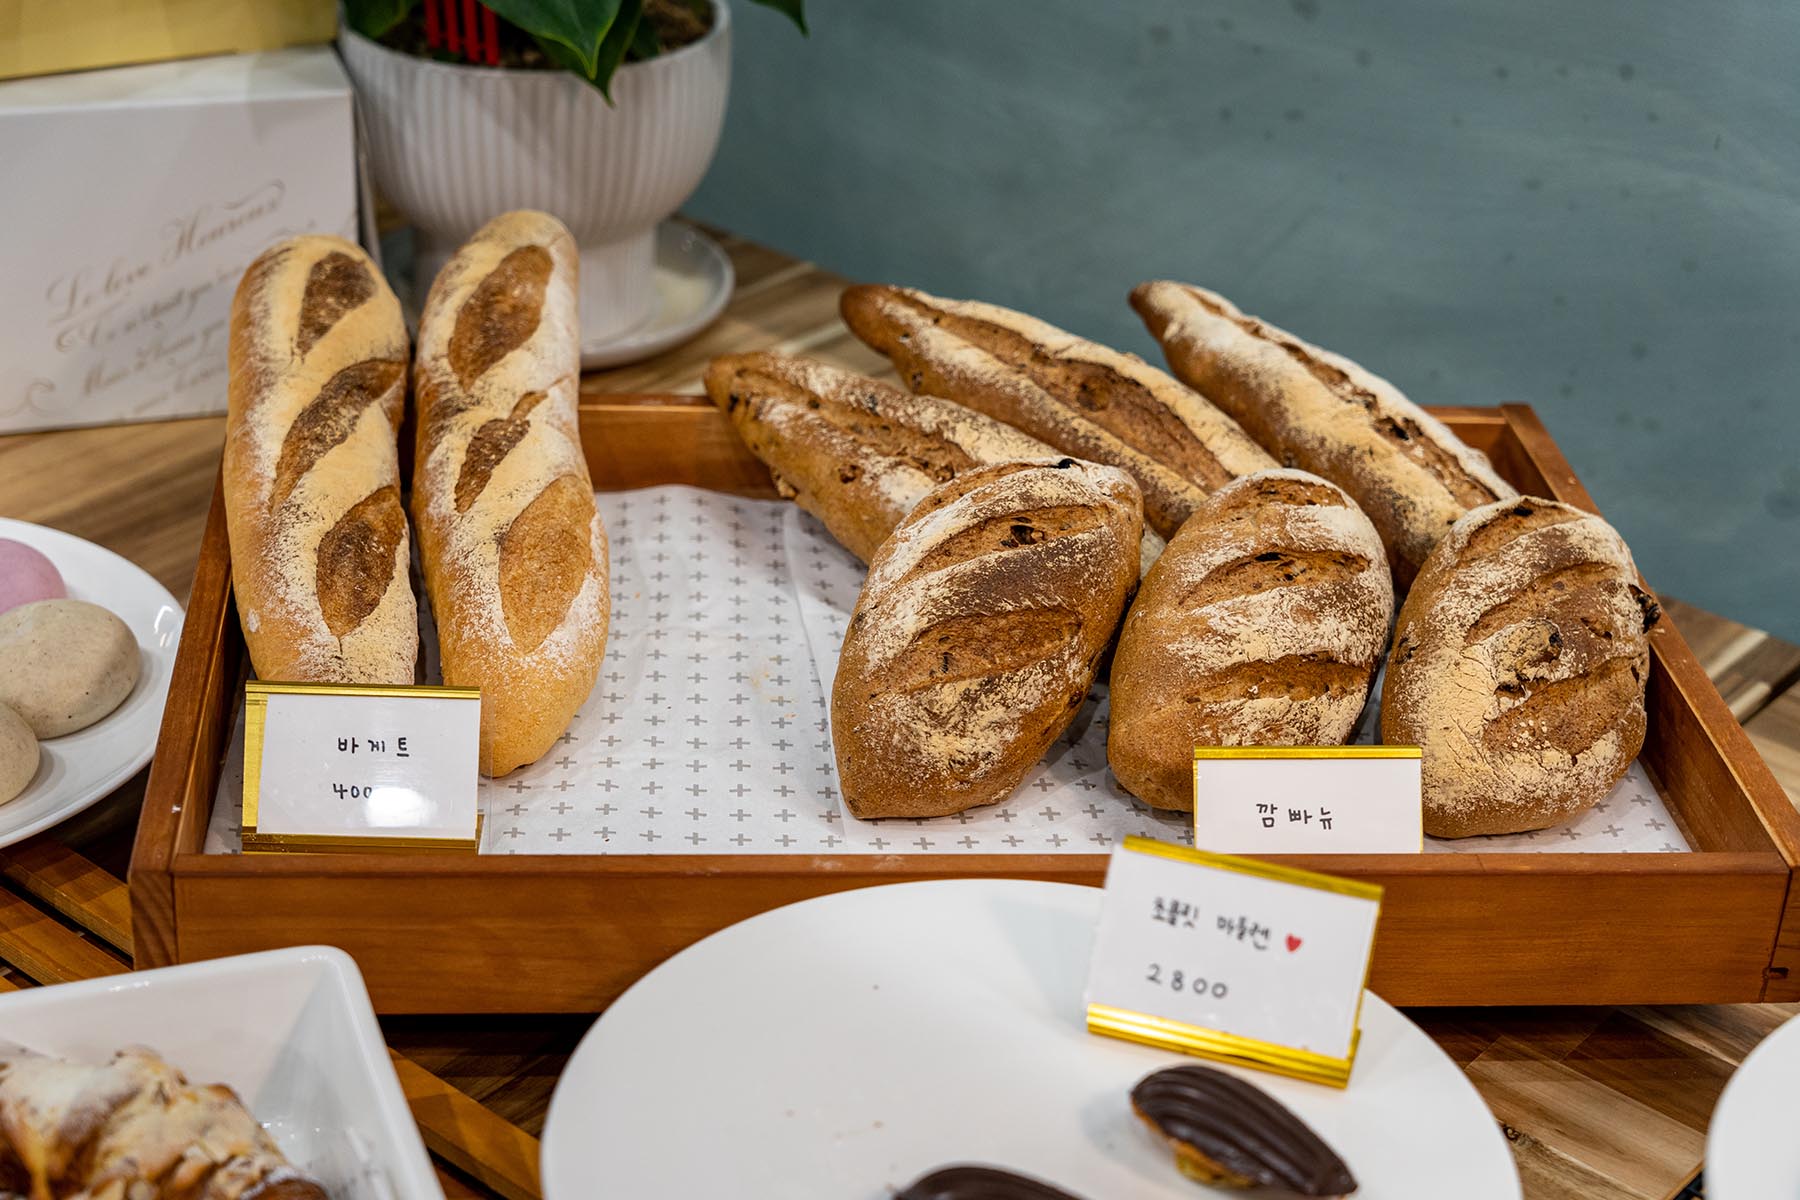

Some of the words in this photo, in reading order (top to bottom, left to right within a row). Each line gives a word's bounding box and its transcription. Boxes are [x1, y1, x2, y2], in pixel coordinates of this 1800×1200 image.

[337, 736, 410, 758] 바게트
[1256, 803, 1333, 830] 깜빠뉴
[1153, 897, 1199, 928] 초콜릿
[1146, 963, 1228, 999] 2800
